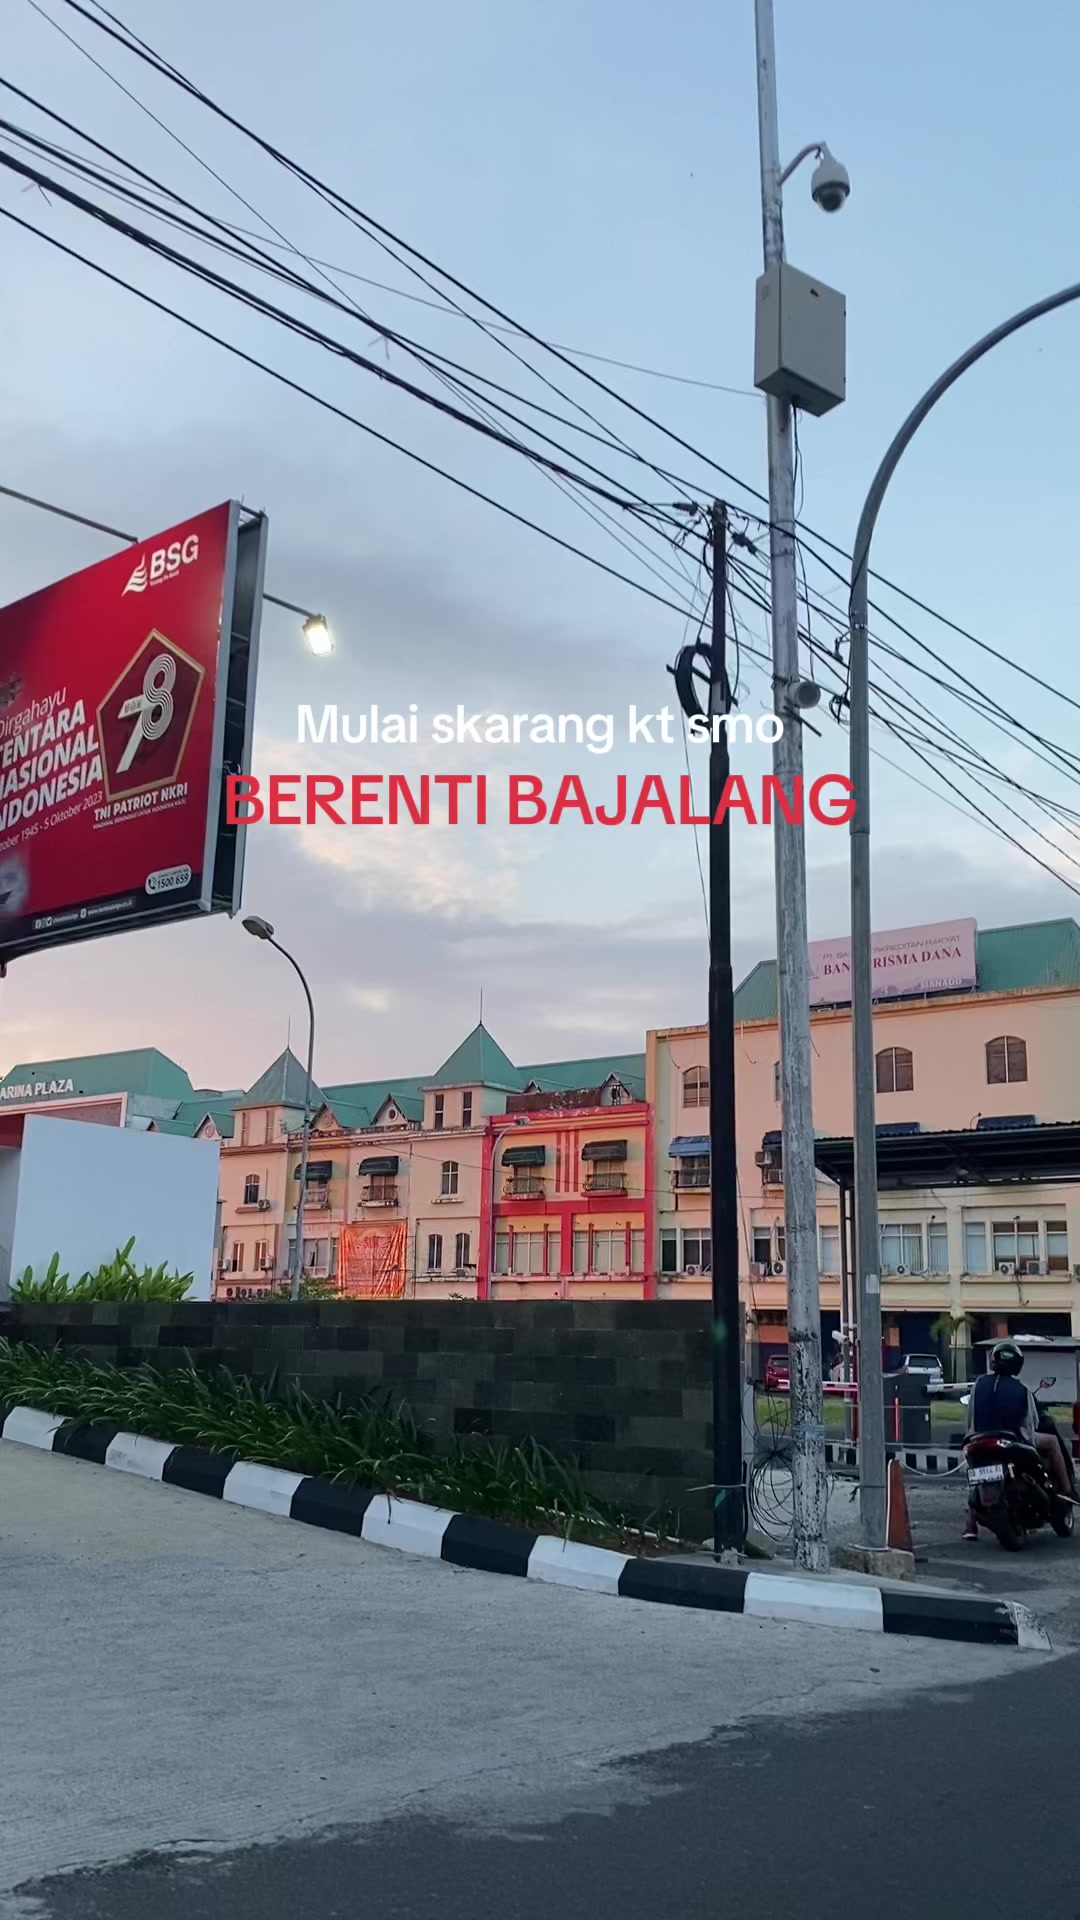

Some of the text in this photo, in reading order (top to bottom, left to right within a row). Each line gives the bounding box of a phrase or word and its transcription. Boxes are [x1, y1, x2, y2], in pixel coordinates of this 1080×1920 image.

[150, 534, 199, 580] BSG
[0, 699, 86, 769] ENTARA
[50, 803, 82, 826] Oktober
[82, 790, 103, 811] 2023
[94, 804, 111, 821] TNI
[113, 790, 159, 816] PATRIOT
[161, 782, 188, 802] NKRI
[824, 946, 962, 975] BAN RISMA DANA
[35, 1078, 74, 1096] PLAZA
